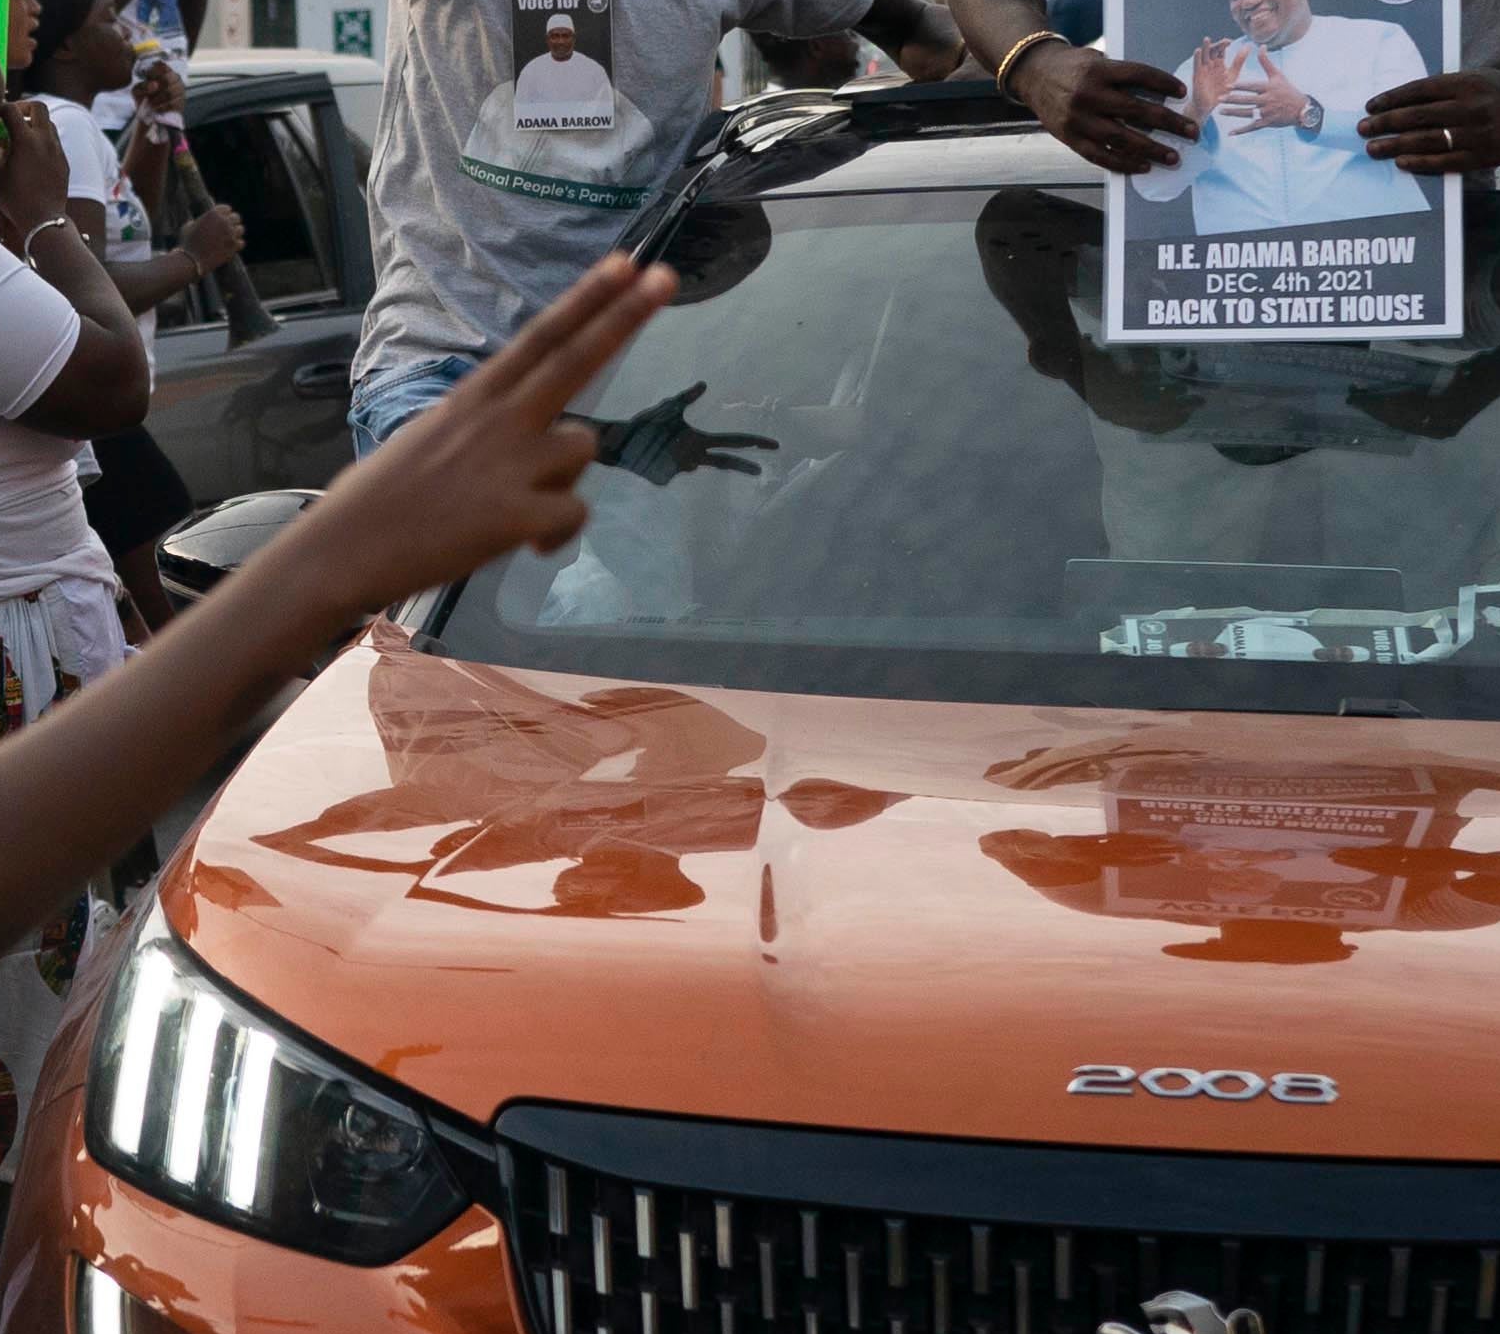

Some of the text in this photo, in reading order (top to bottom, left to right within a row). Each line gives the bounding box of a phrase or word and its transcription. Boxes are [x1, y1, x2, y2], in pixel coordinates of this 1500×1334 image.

[516, 115, 612, 129] ADAMA BARROW
[512, 175, 576, 199] People's
[578, 187, 618, 207] Party
[1158, 236, 1416, 270] H.E. ADAMA BARROW
[1206, 269, 1373, 294] DEC. 4th 2021
[1147, 294, 1425, 325] BACK TO STATE HOUSE
[1066, 1064, 1340, 1103] 2008
